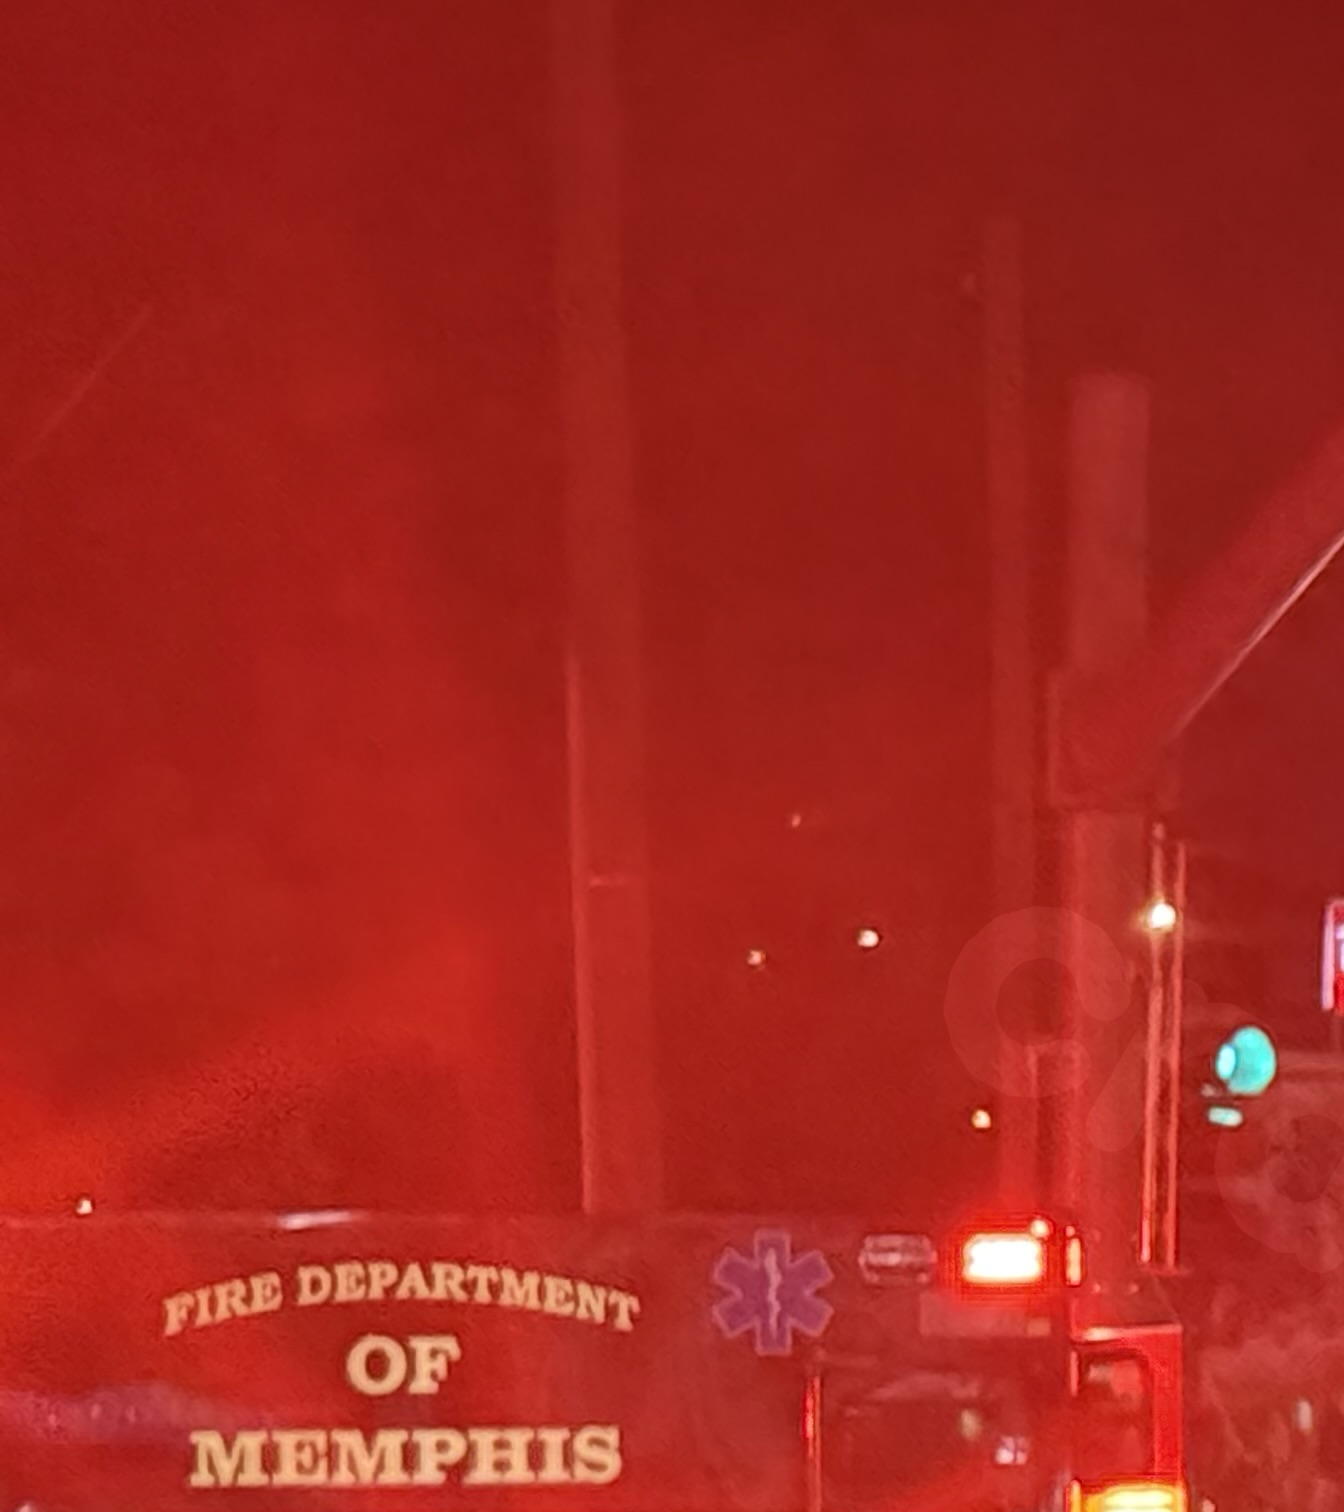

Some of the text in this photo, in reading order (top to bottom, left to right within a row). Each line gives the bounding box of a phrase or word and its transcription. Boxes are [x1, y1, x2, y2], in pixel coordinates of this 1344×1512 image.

[162, 1259, 640, 1337] FIRE DEPARTMENT
[346, 1334, 461, 1395] OF
[188, 1424, 624, 1488] MEMPHIS
